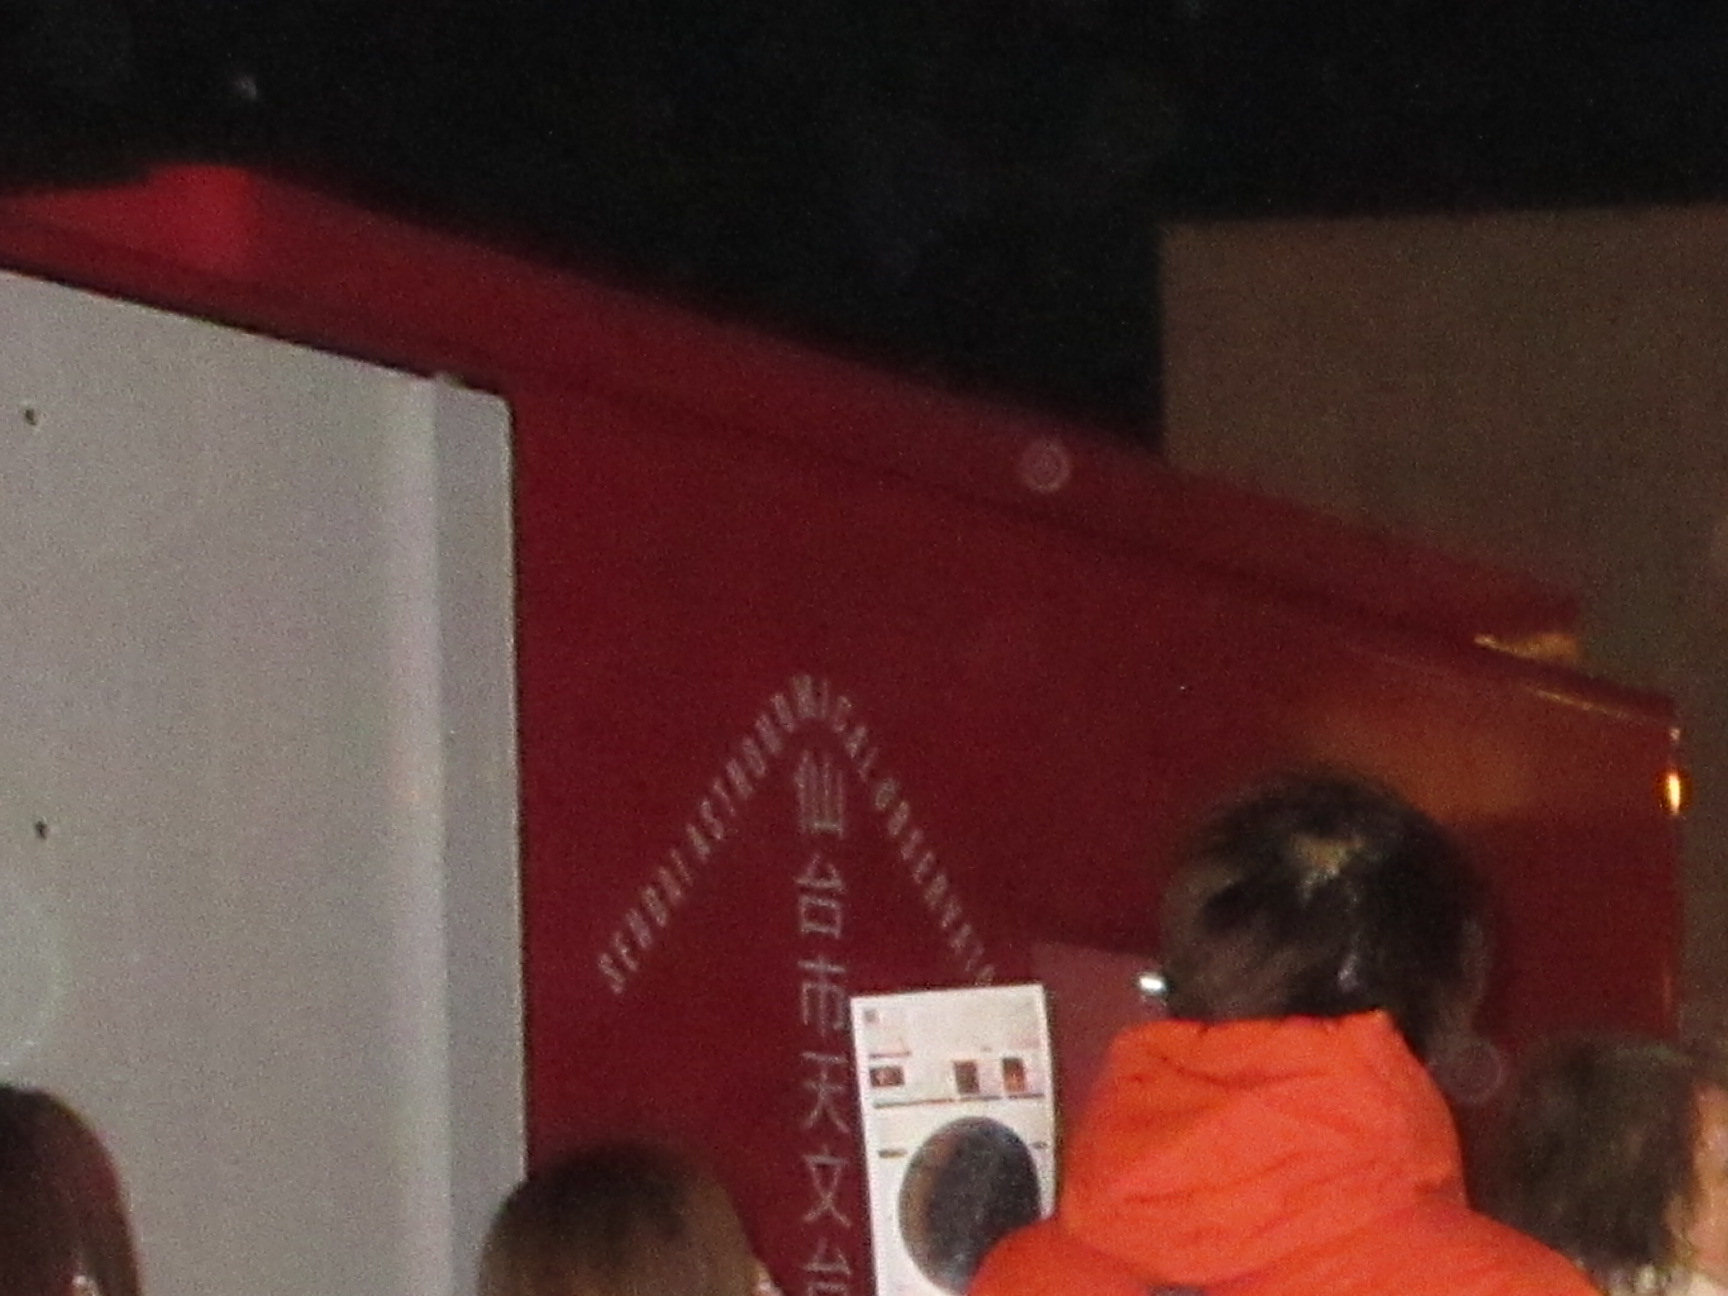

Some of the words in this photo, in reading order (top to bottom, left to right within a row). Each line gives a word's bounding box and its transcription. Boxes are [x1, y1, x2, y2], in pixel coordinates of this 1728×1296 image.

[598, 848, 694, 995] SENDAI
[685, 672, 879, 864] ASTRONOMICAL
[872, 776, 997, 987] OBSERVATO
